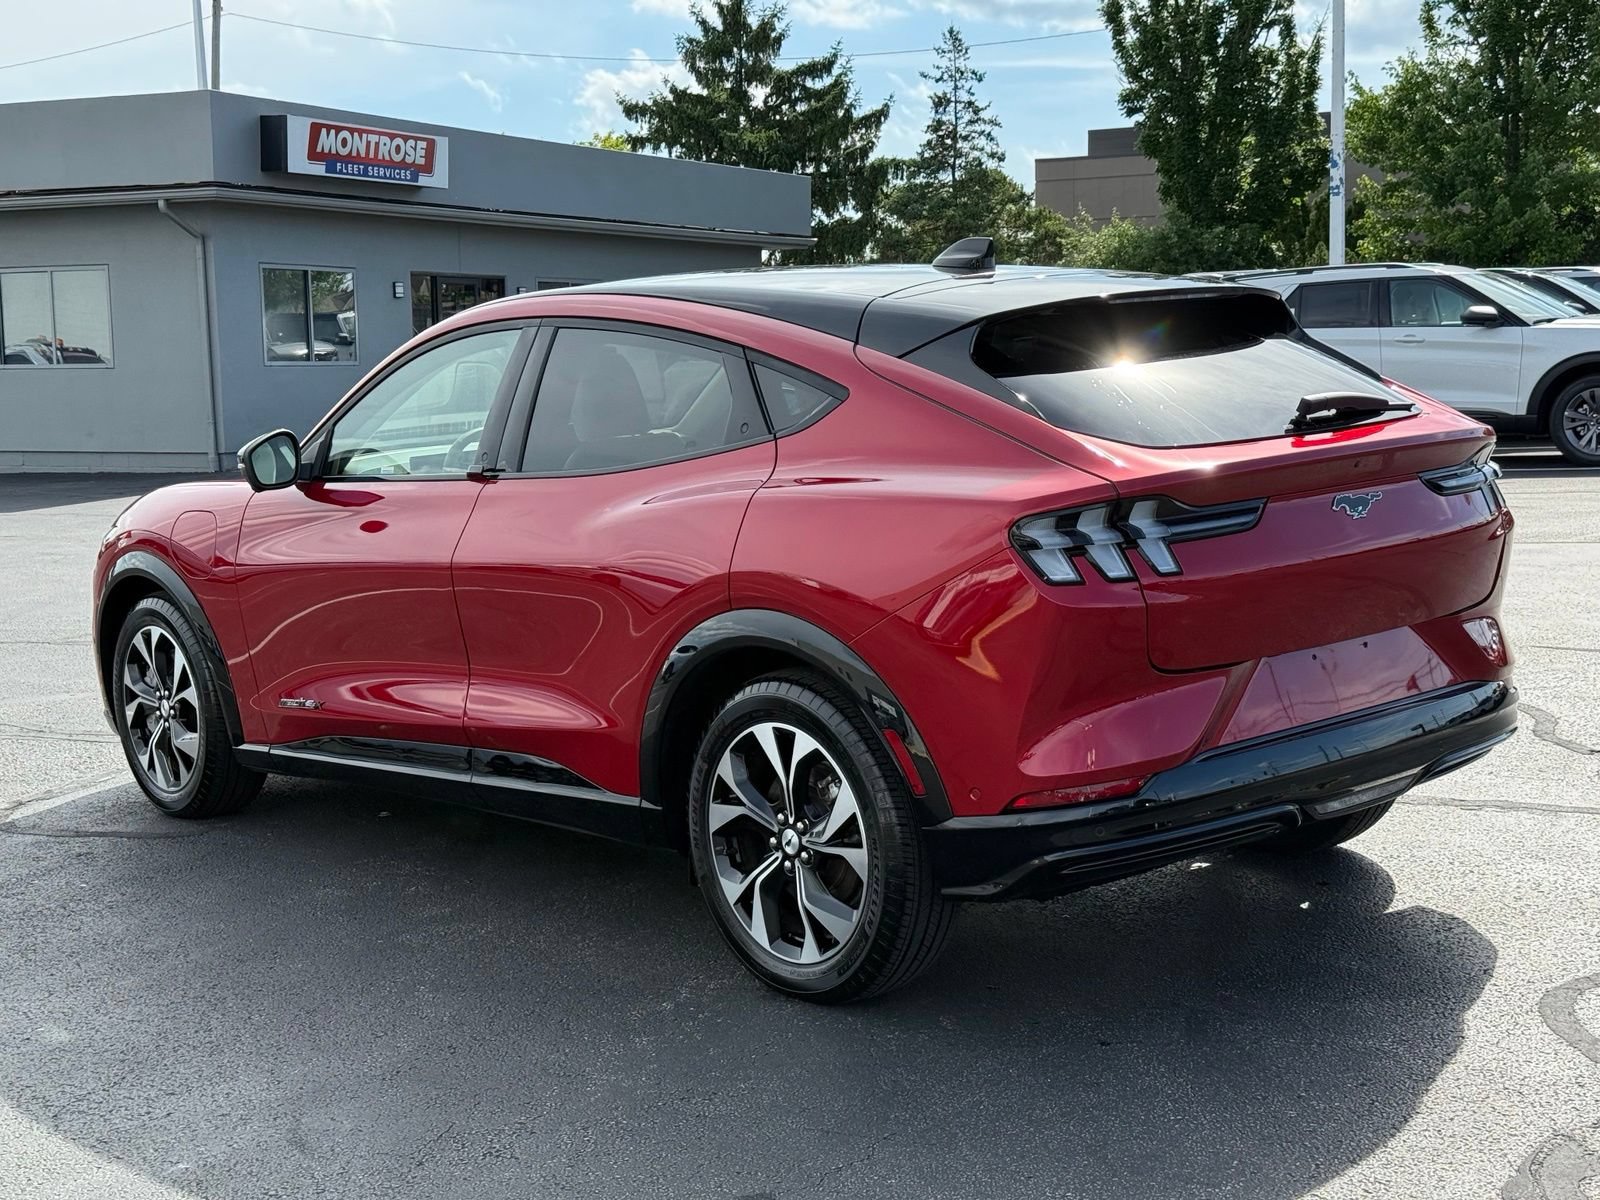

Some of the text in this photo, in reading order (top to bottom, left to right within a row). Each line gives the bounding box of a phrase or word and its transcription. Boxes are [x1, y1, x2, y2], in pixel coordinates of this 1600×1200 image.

[316, 128, 427, 165] MONTROSE
[336, 162, 411, 179] FLEET SERVICES
[691, 765, 705, 851] MICHELIN
[867, 838, 881, 930] MICHELIN
